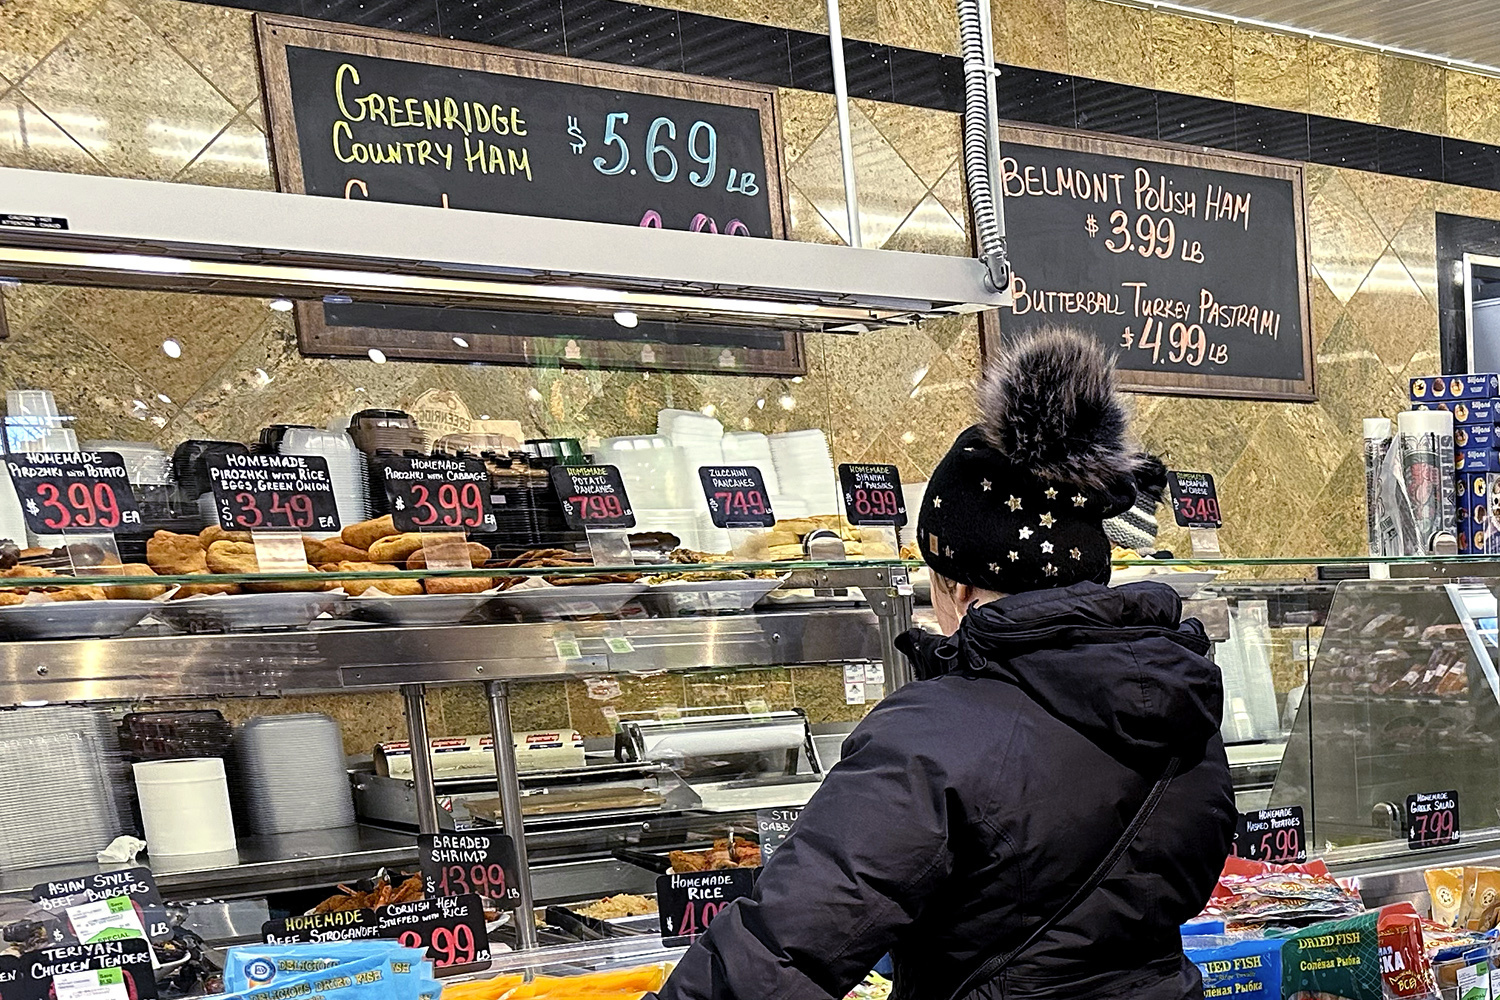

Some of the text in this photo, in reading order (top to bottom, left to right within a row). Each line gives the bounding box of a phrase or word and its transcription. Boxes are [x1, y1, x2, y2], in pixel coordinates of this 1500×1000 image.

[335, 63, 527, 137] GREENRIDGE
[725, 168, 760, 197] LB
[332, 120, 532, 181] COUNTRY HAM
[1000, 157, 1125, 204] BELMONT
[1205, 184, 1251, 230] HAM
[1181, 239, 1205, 264] LB
[1010, 272, 1281, 340] BUTTERBALL TURKEY PASTRAMI
[1208, 343, 1229, 364] LB
[26, 452, 102, 465] HOMEMADE
[226, 454, 308, 468] HOMEMADE
[411, 458, 466, 472] HOMEMADE
[86, 464, 126, 478] POTATO
[211, 468, 268, 481] PIROZHKI
[447, 471, 487, 481] CABBAGE
[849, 465, 891, 474] HOMEMADE
[258, 480, 293, 492] GREEN
[296, 479, 330, 492] ONION
[572, 476, 607, 485] POTATO
[713, 478, 755, 488] PANCAKES
[122, 510, 141, 524] EA
[318, 516, 336, 528] EA
[485, 514, 496, 525] EA
[1417, 792, 1448, 802] HOMEMADE
[1434, 799, 1455, 811] SALAD
[1258, 808, 1292, 819] HOMEMADE
[433, 836, 490, 850] BREADED
[431, 850, 488, 863] SHRIMP
[49, 872, 135, 896] ASIAN STYLE
[671, 875, 734, 889] HOMEMADE
[39, 881, 150, 911] BEEF BURGERS
[507, 888, 520, 899] LB
[688, 887, 724, 900] RICE
[387, 897, 459, 916] CORNISH HEN
[285, 910, 364, 932] HOMEMADE
[379, 915, 420, 929] STUFFED
[442, 906, 469, 918] RICE
[150, 922, 170, 937] LB
[309, 925, 379, 944] STROGANOFF
[1298, 932, 1360, 949] DRIED FISH
[41, 942, 123, 961] TERIYAKI
[477, 950, 491, 961] LB
[31, 959, 90, 979] CHICKEN
[93, 952, 150, 968] TENDERS
[278, 959, 341, 971] DELICIOU
[1234, 955, 1263, 969] FISH
[314, 976, 352, 992] DRIED
[355, 969, 383, 985] FISH
